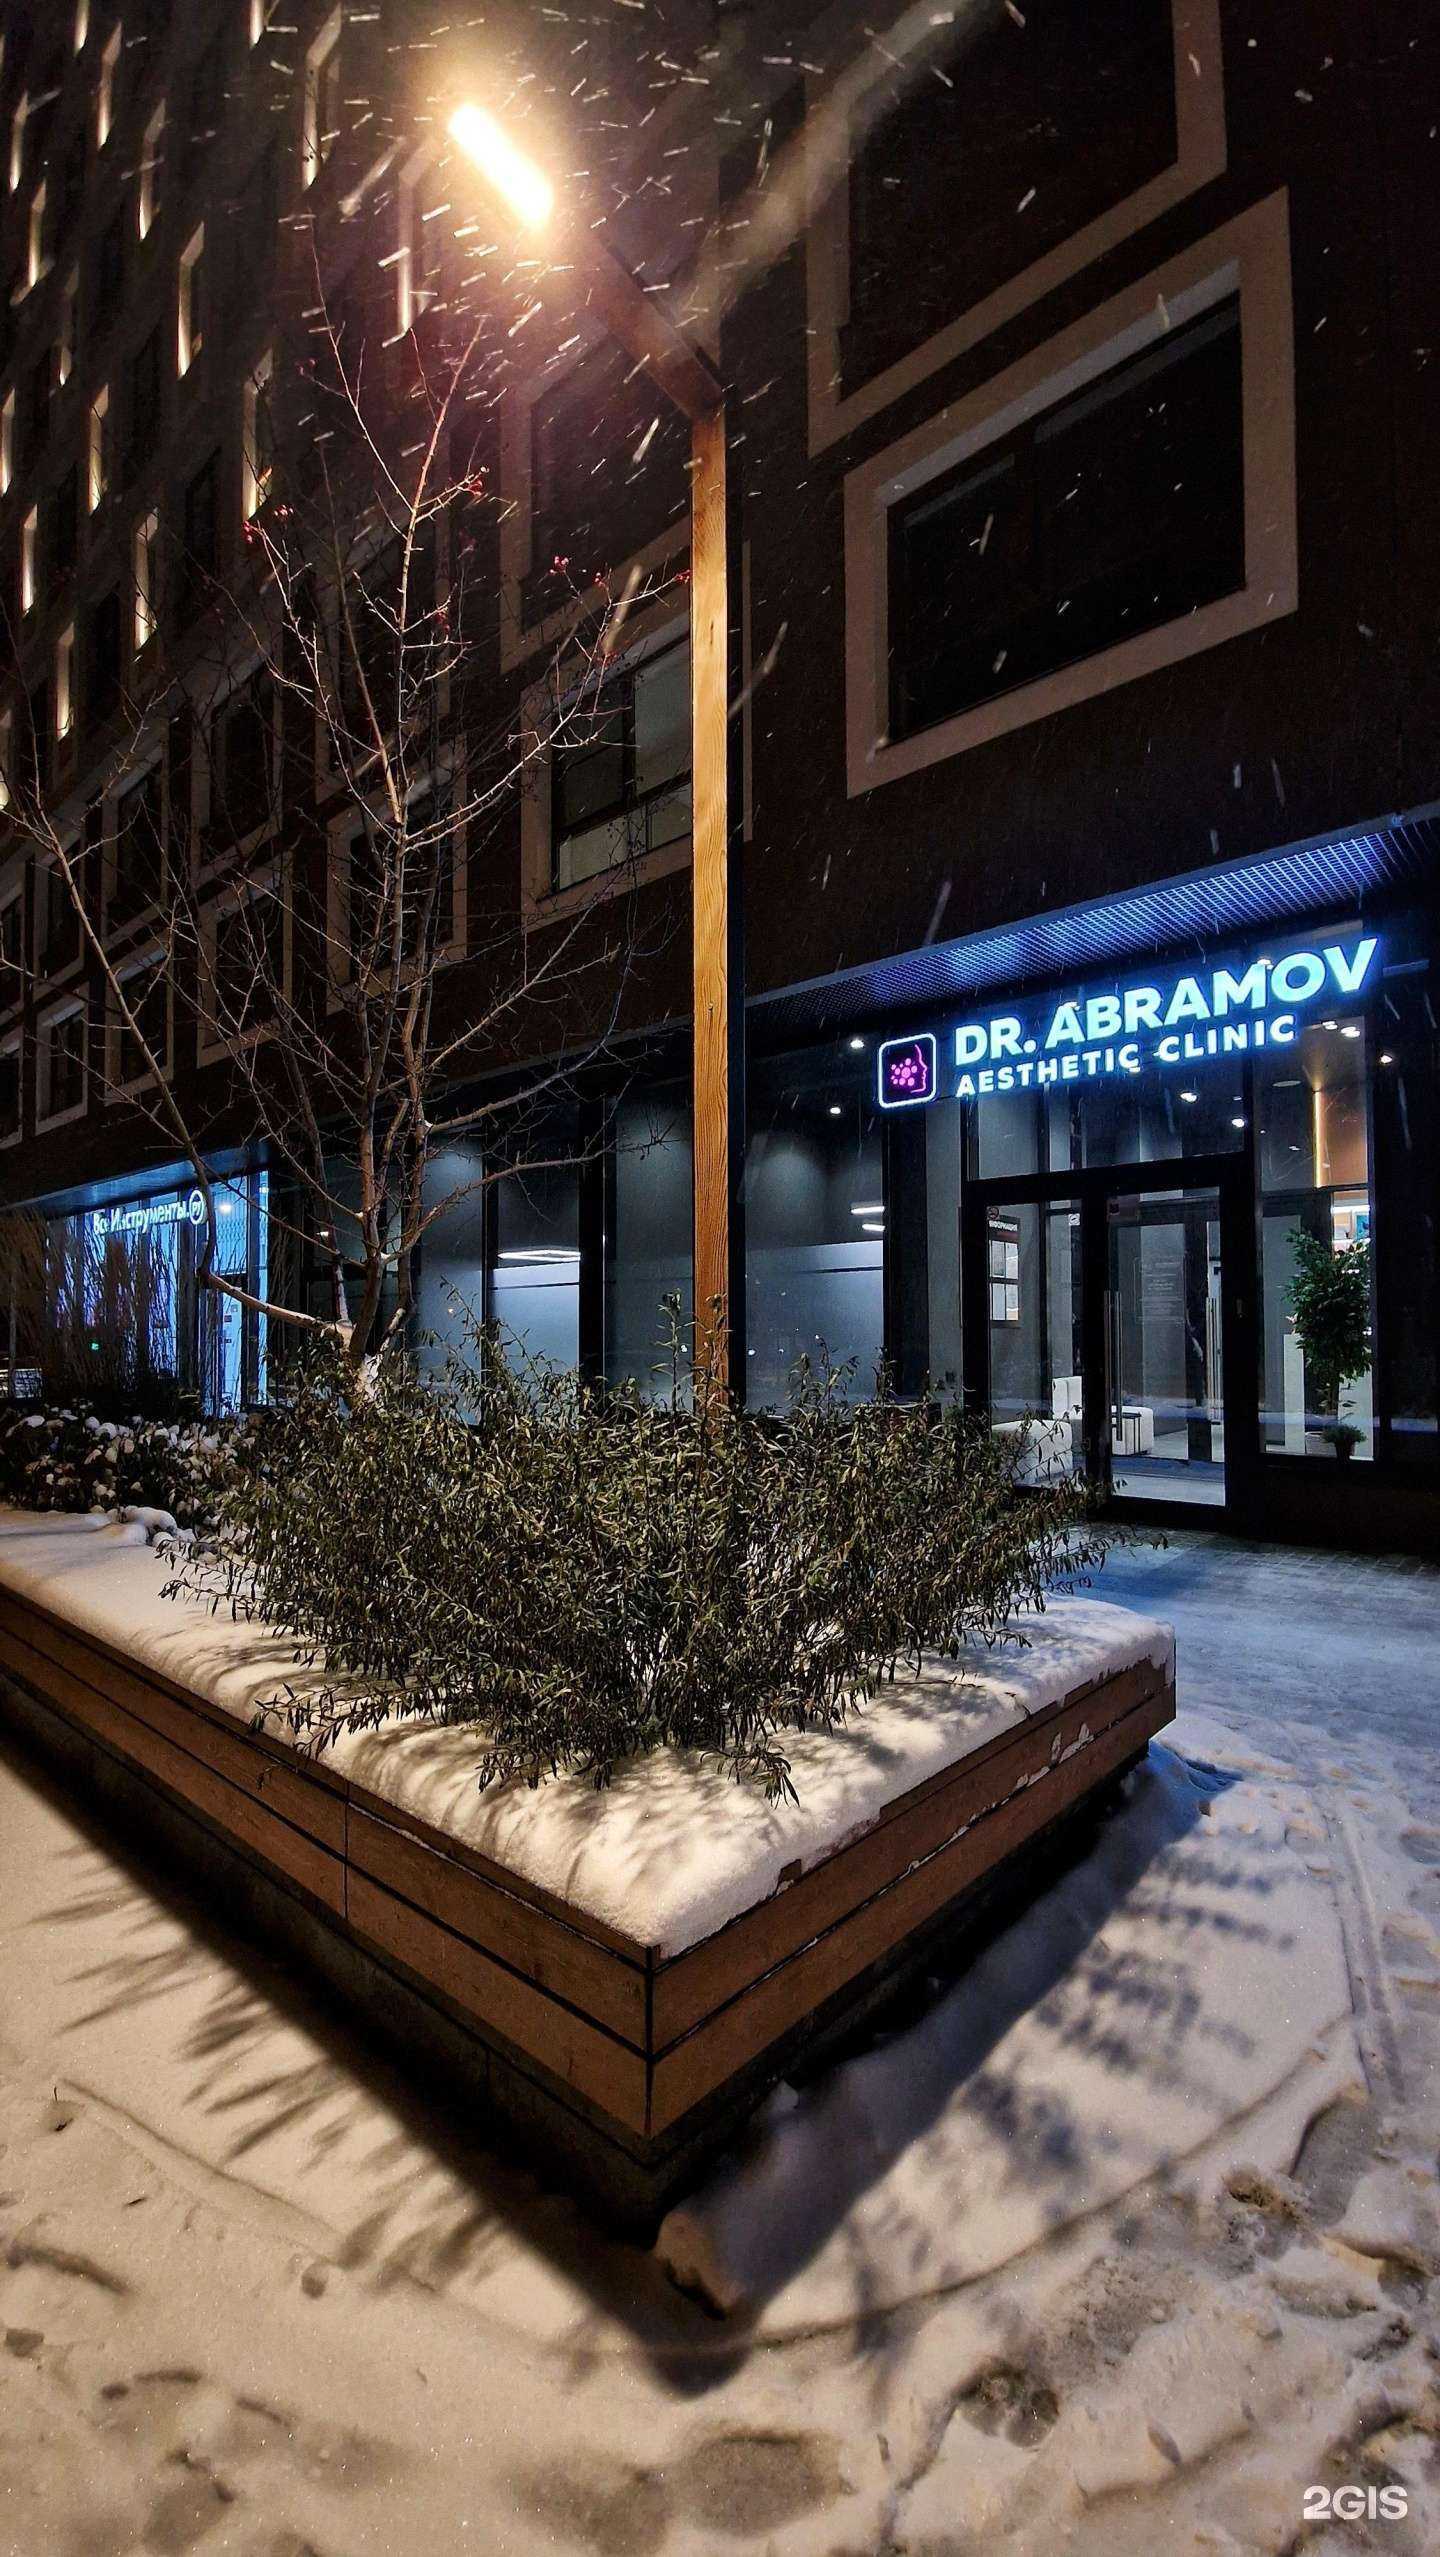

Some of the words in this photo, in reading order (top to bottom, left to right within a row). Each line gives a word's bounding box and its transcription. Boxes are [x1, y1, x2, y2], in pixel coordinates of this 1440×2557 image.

[955, 1016, 1037, 1066] DR.
[1044, 938, 1378, 1049] ABRAMOV
[955, 1043, 1140, 1098] AESTHETIC
[1158, 1014, 1295, 1062] CLINIC
